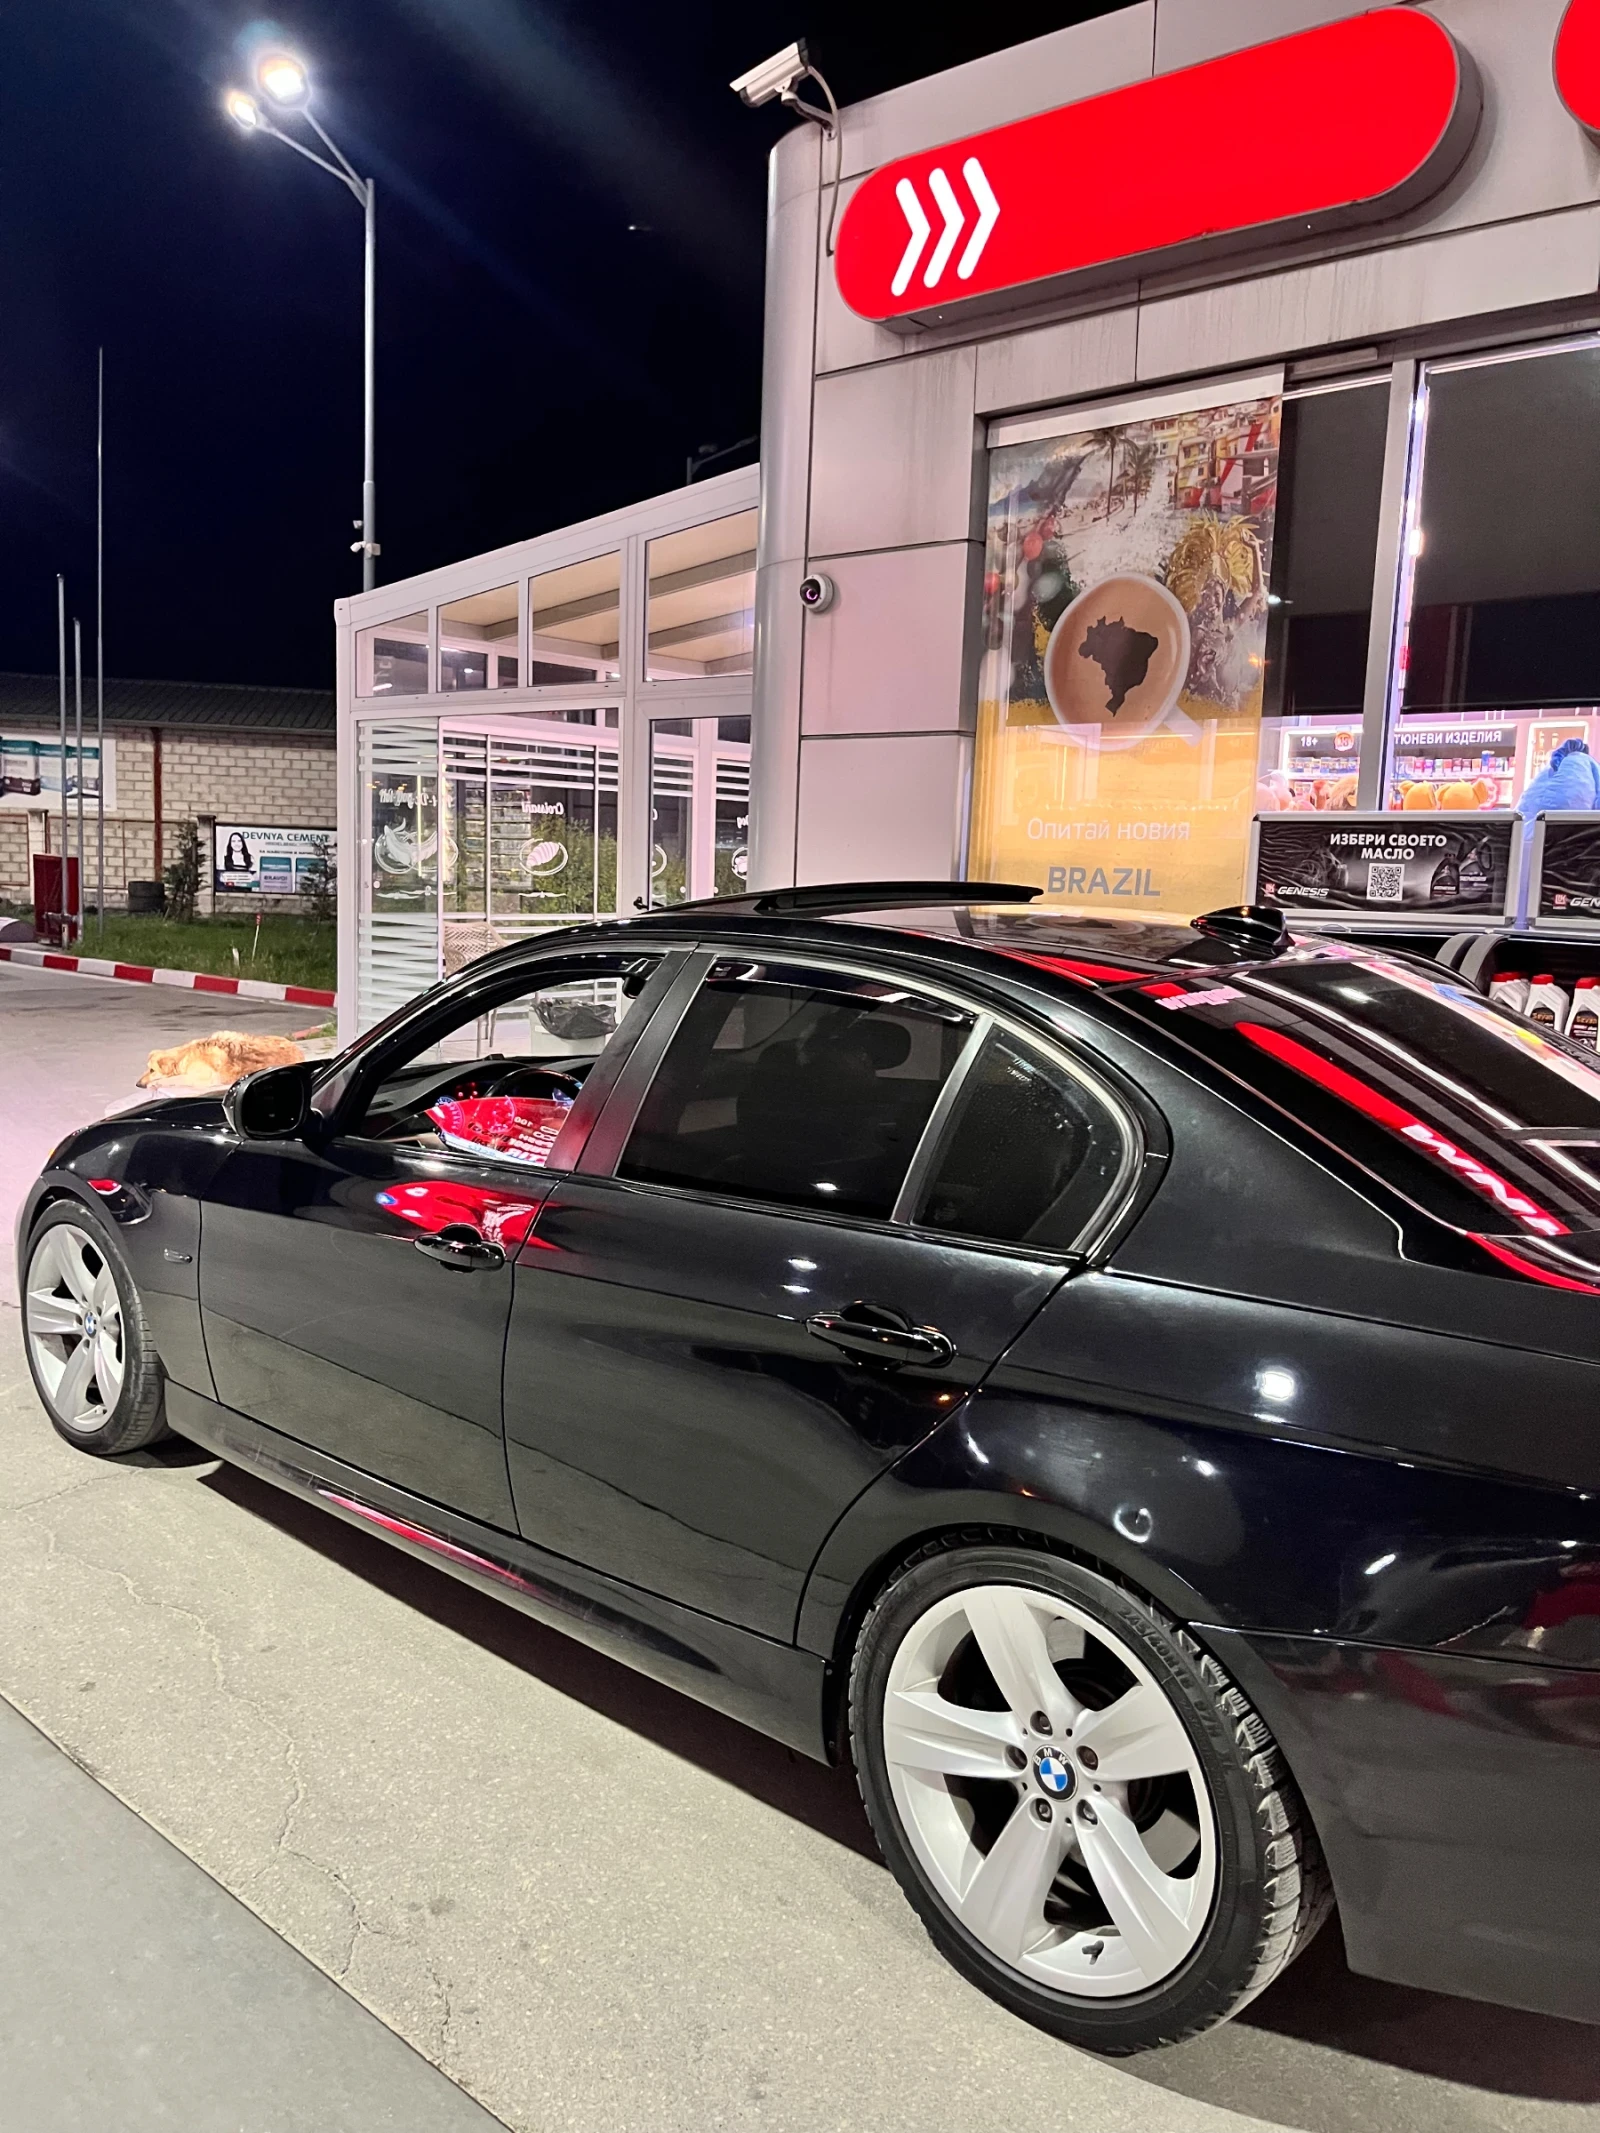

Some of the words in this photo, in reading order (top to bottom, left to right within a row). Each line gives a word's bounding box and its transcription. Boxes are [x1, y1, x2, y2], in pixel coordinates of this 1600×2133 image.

[1301, 736, 1318, 747] 18+
[1445, 730, 1501, 744] ИЗДЕЛИЯ
[1027, 817, 1110, 840] Опитай
[1117, 821, 1190, 840] новия
[242, 831, 283, 841] DEVNYA
[1330, 833, 1386, 846] ИЗБЕРИ
[1388, 834, 1447, 847] СВОЕТО
[1361, 848, 1415, 860] МАСЛО
[1047, 866, 1161, 896] BRAZIL
[1277, 886, 1330, 896] GENESIS
[1033, 1747, 1070, 1766] BMW
